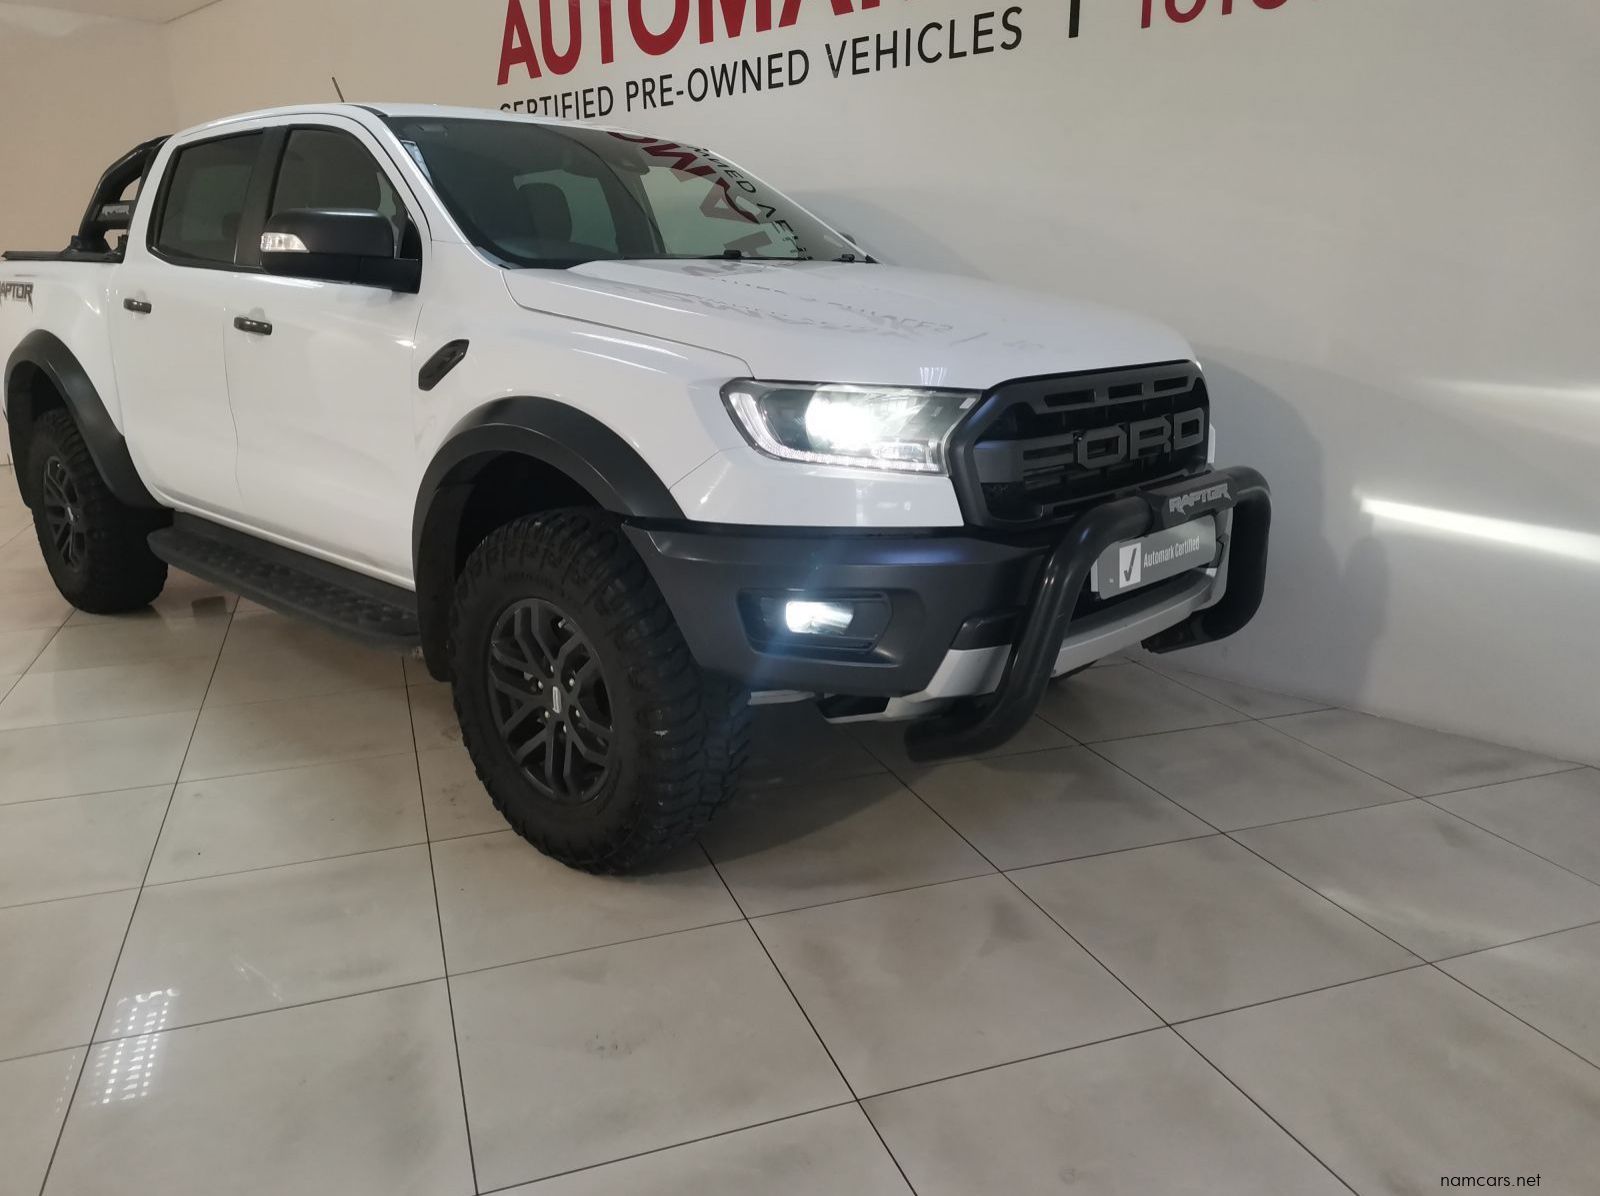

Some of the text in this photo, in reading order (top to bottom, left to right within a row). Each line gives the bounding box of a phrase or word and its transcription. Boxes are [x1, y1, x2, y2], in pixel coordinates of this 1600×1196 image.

[626, 49, 809, 112] PRE-OWNED
[825, 6, 1022, 79] VEHICLES
[0, 281, 34, 312] APTOR
[998, 408, 1205, 484] FORD
[1143, 536, 1200, 568] Automark Certified
